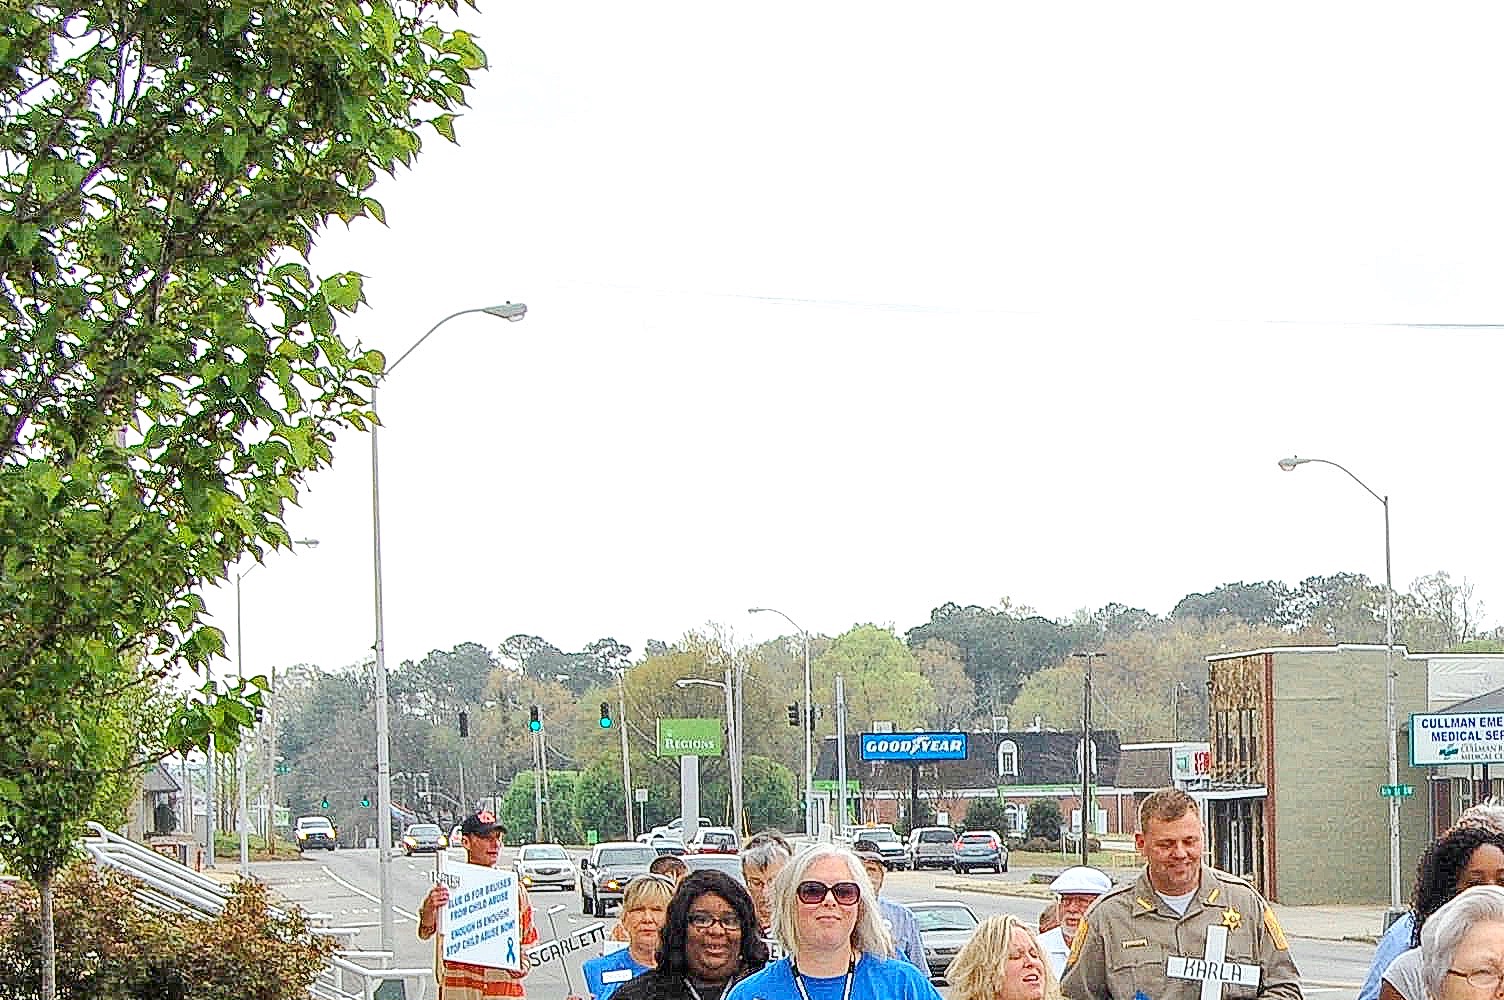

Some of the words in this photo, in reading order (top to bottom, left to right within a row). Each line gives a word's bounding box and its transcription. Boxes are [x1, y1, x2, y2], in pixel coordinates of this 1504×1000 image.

[1421, 717, 1476, 729] CULLMAN
[1431, 731, 1482, 742] MEDICAL
[866, 738, 962, 753] GOODYEAR
[529, 926, 606, 967] SCARLETT
[1184, 957, 1242, 981] KARLA
